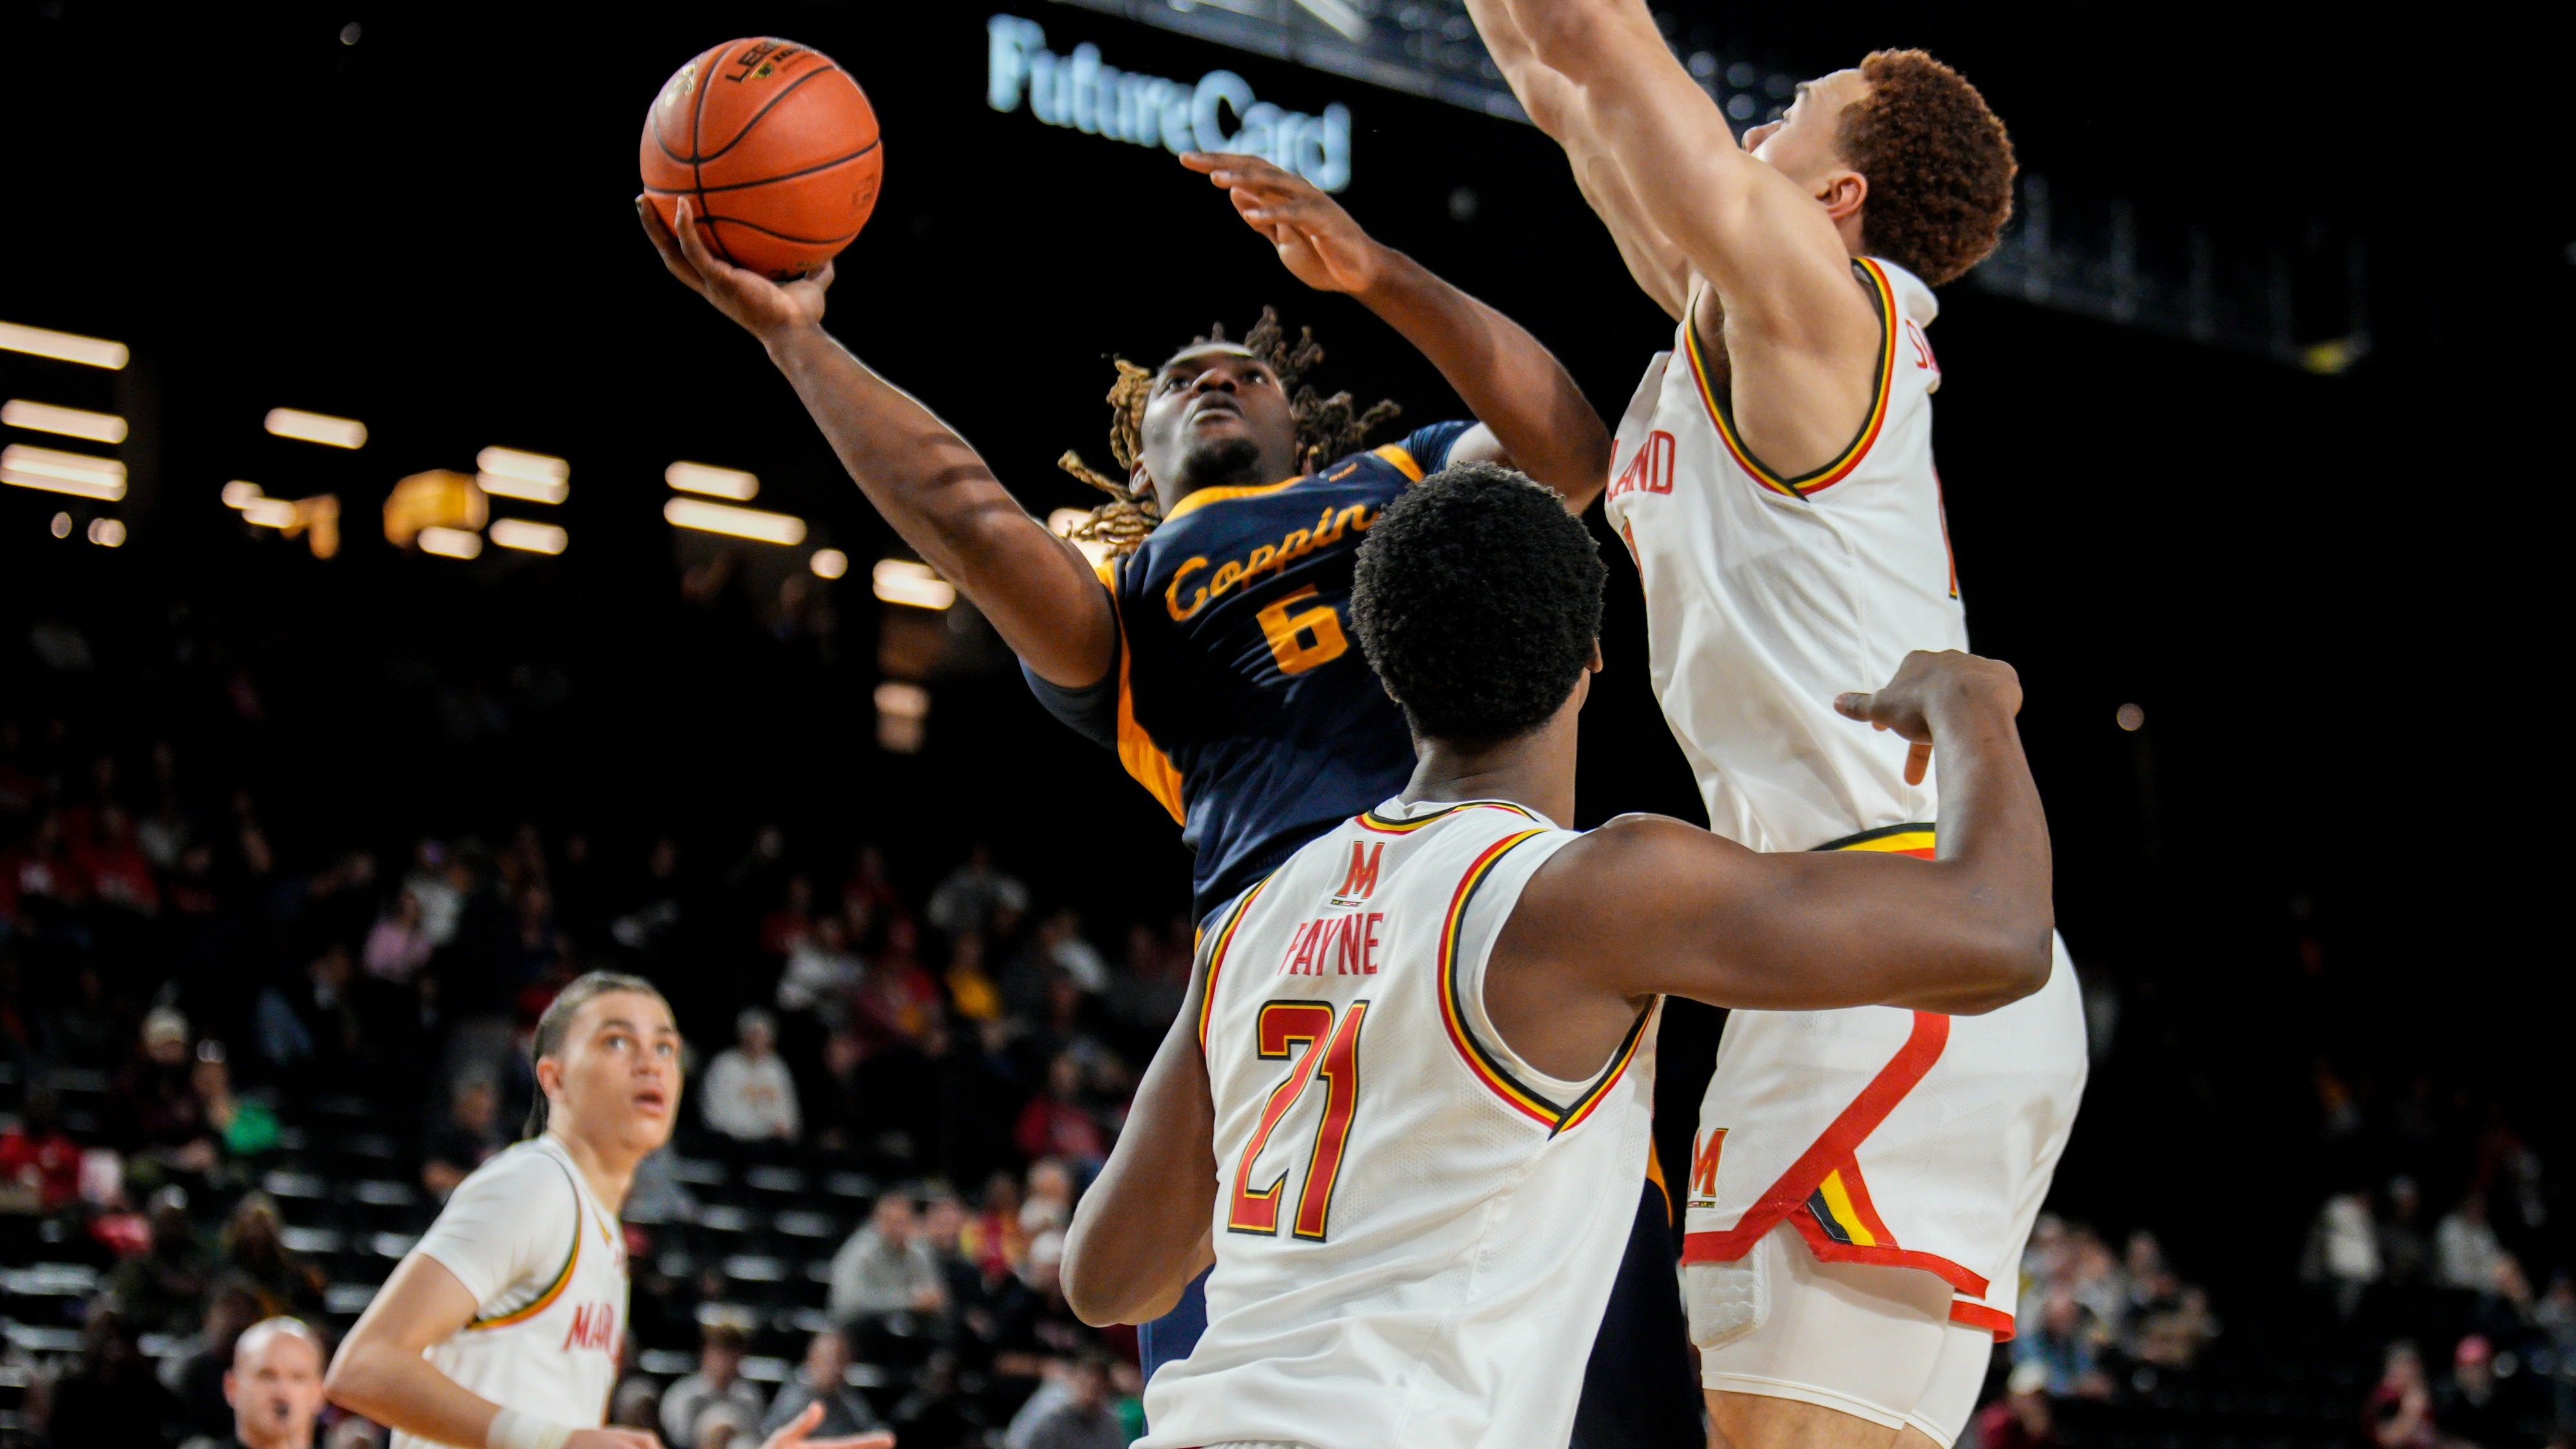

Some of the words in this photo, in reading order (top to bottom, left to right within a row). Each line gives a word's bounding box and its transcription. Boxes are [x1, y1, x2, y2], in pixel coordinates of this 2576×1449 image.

[987, 13, 1351, 193] FutureCard
[1256, 583, 1349, 674] 6
[1334, 840, 1386, 899] M
[1227, 1000, 1370, 1242] 21
[1687, 1128, 1729, 1198] M
